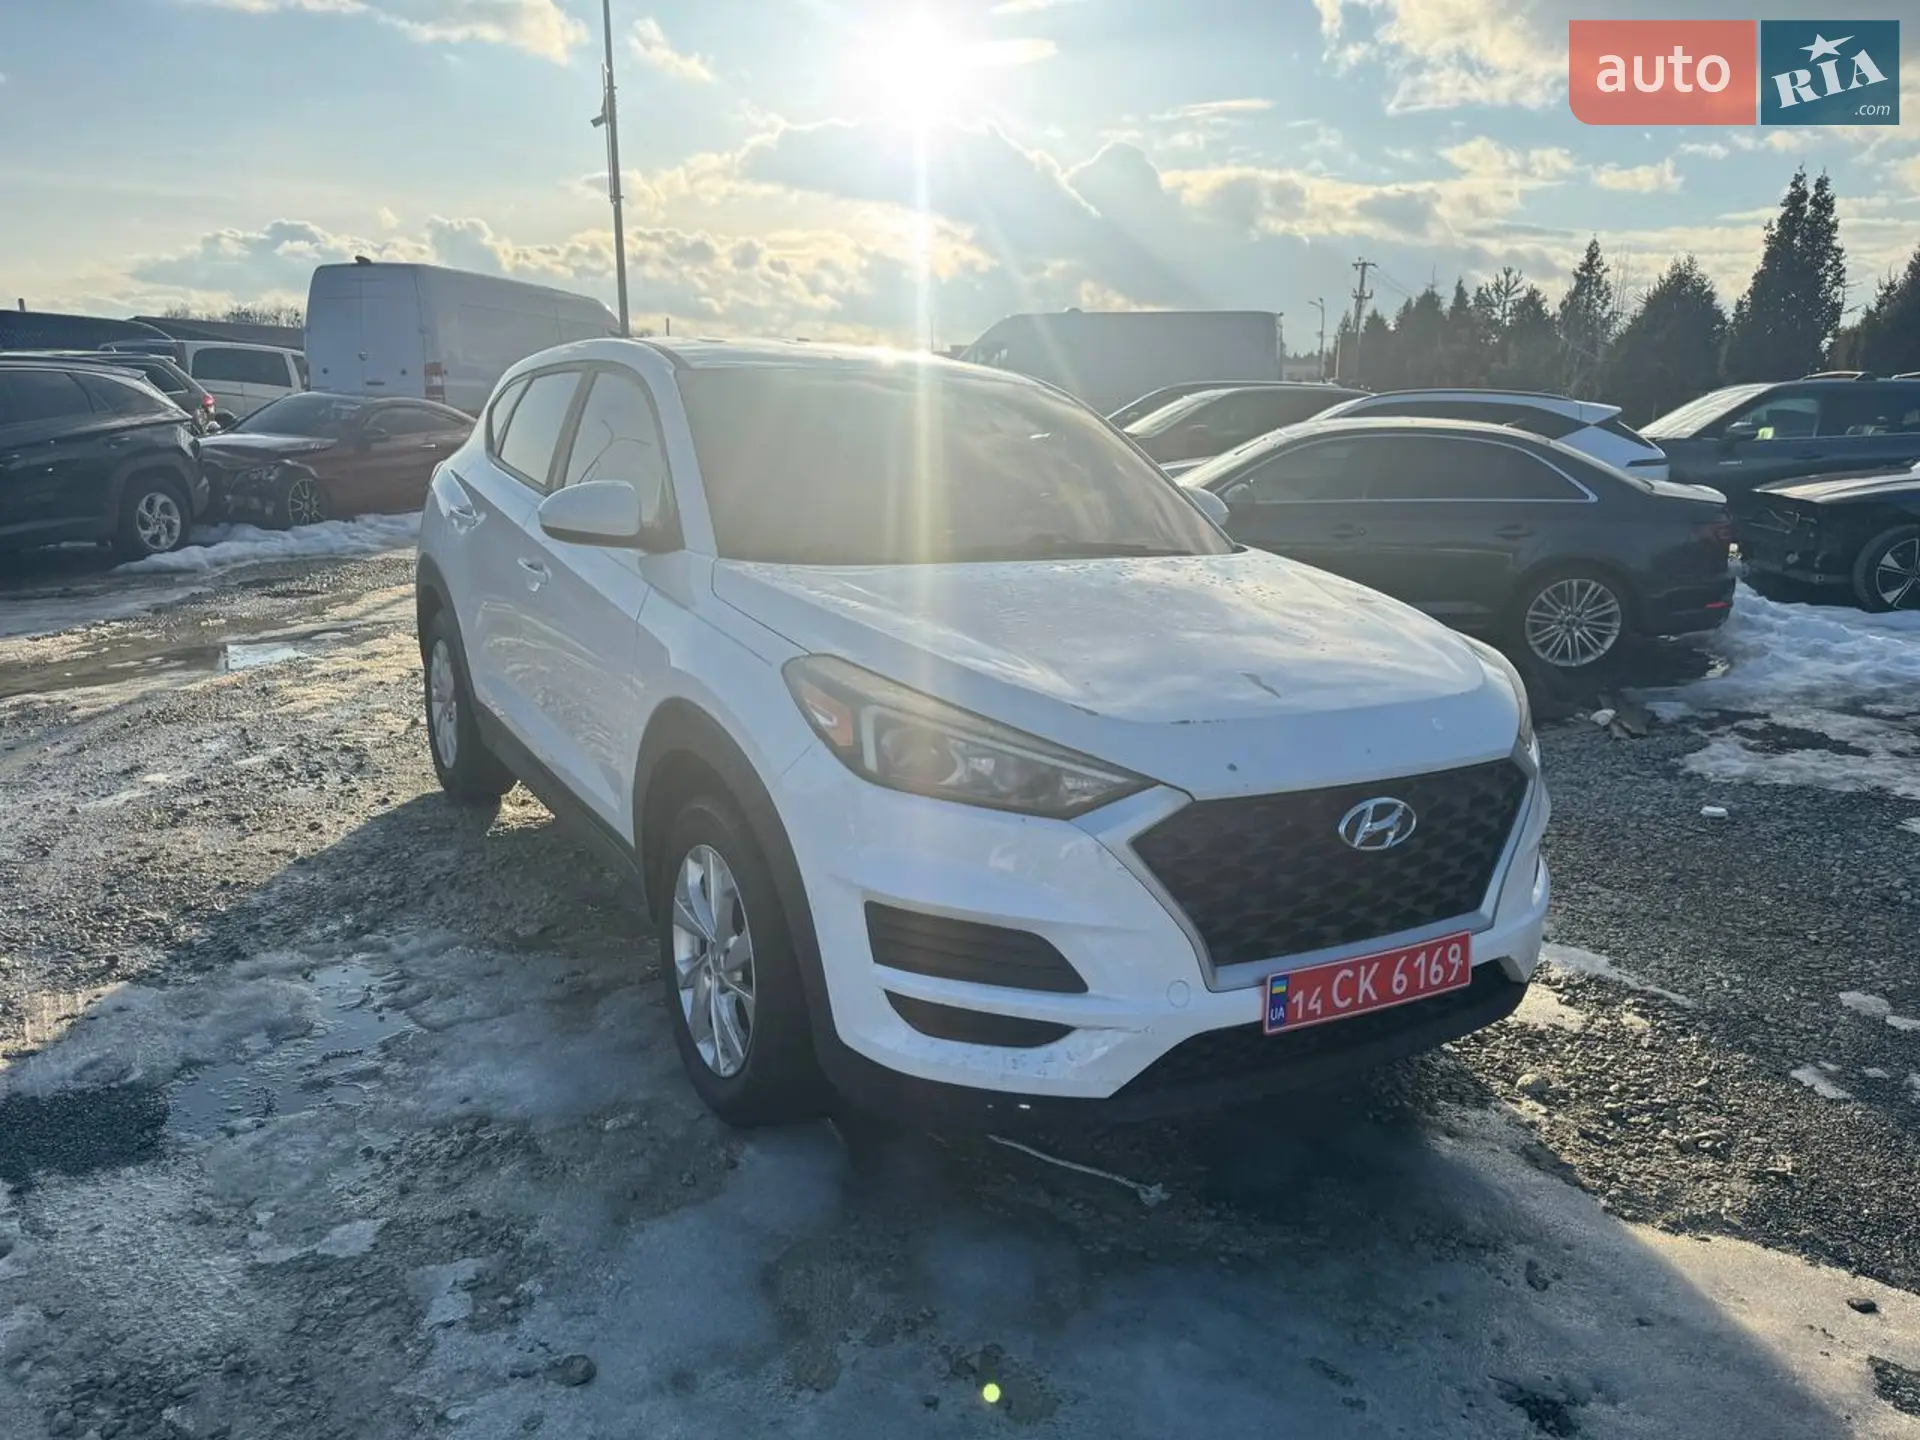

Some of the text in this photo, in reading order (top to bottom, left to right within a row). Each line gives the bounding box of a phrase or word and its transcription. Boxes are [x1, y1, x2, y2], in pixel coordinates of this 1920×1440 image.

[1292, 943, 1463, 1020] 14 CK 6169
[1270, 1006, 1285, 1021] UA
